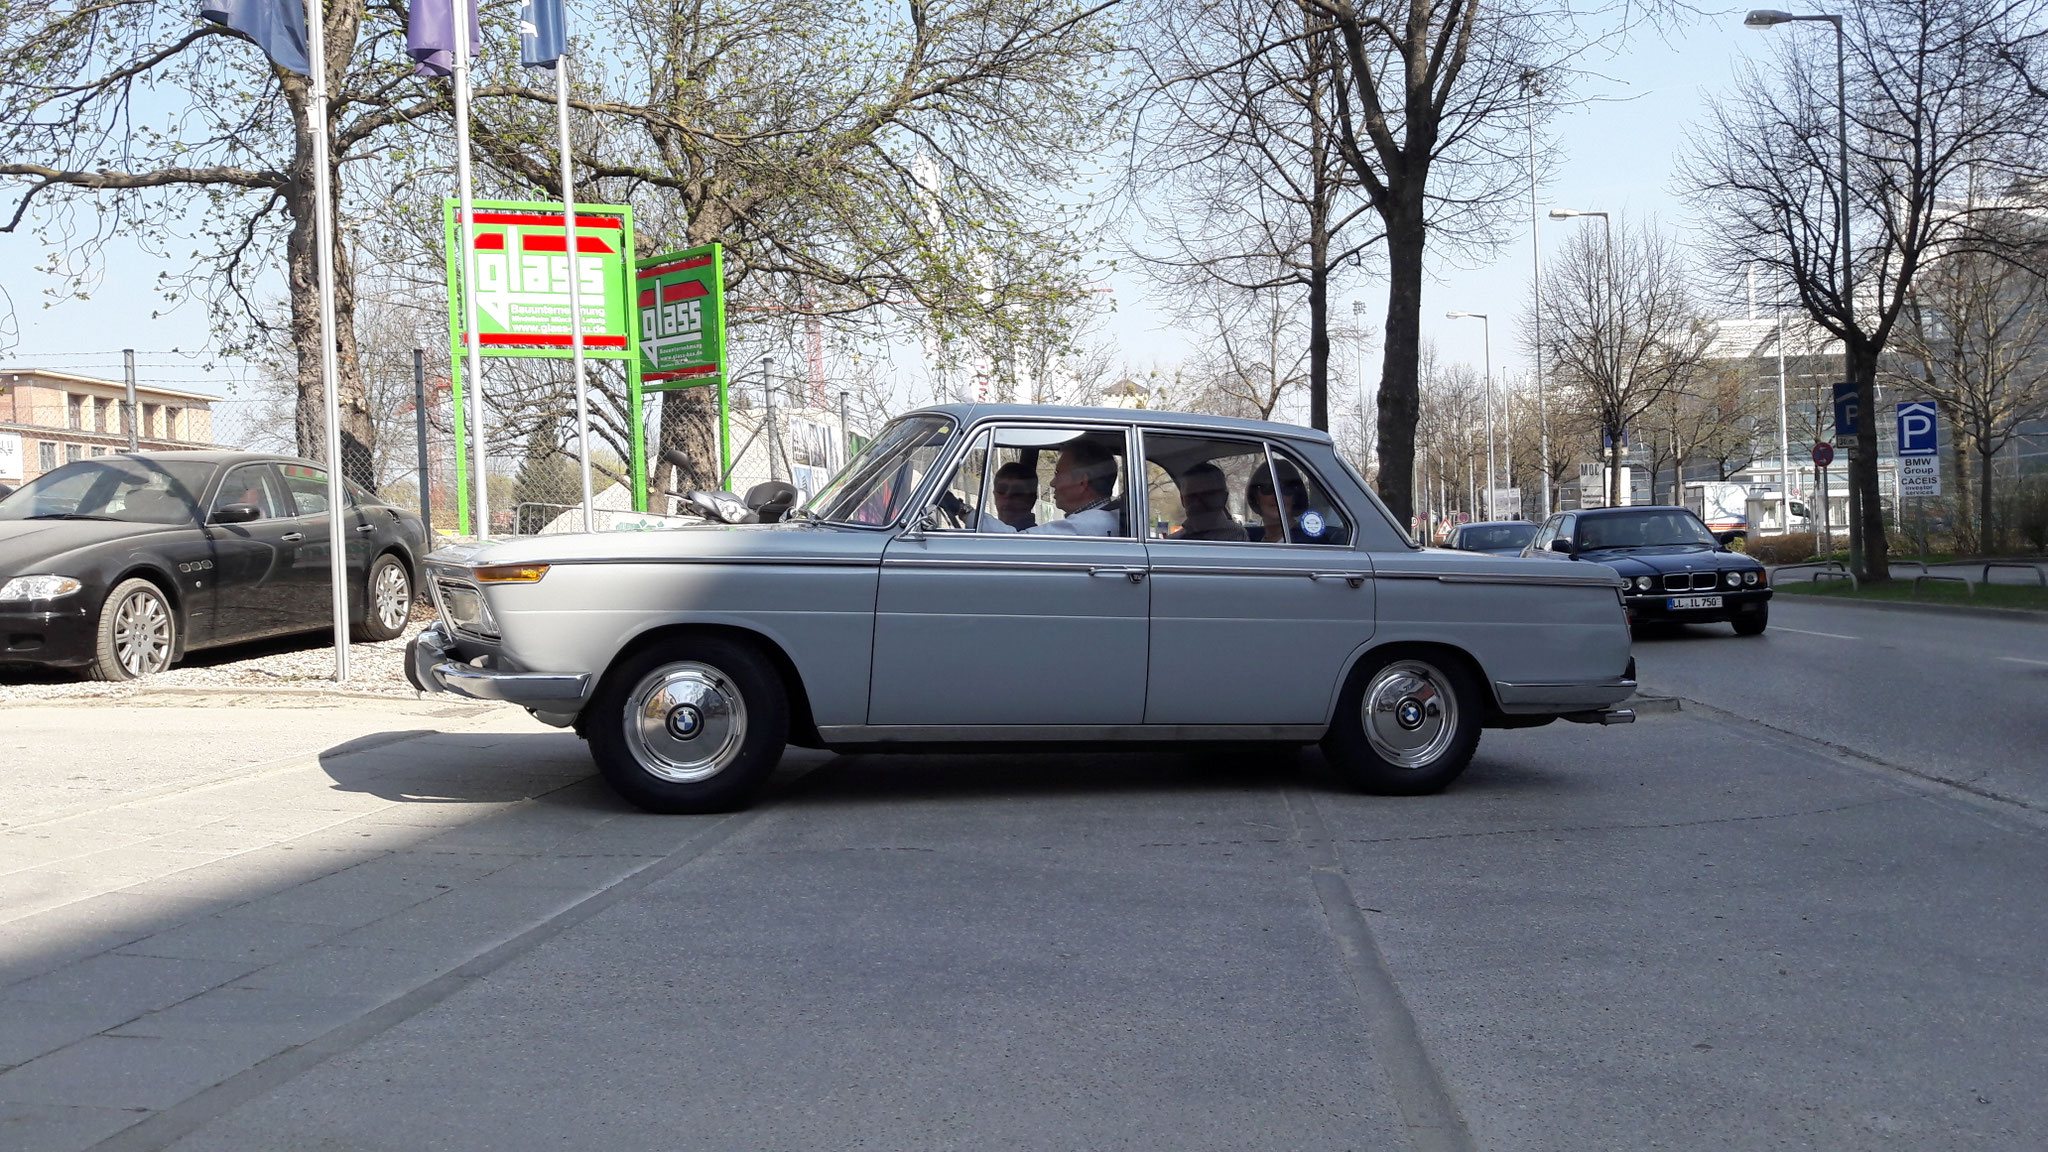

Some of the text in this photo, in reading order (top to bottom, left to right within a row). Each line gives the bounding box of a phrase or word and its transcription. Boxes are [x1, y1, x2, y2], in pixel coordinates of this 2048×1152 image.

[640, 278, 703, 369] glass
[1903, 415, 1931, 448] P
[1905, 458, 1931, 466] BMW
[1580, 463, 1600, 476] MOC
[1903, 467, 1934, 475] Group
[1901, 477, 1937, 485] CACEIS
[1673, 599, 1684, 608] LL
[1690, 598, 1700, 607] IL
[1701, 597, 1717, 607] 750
